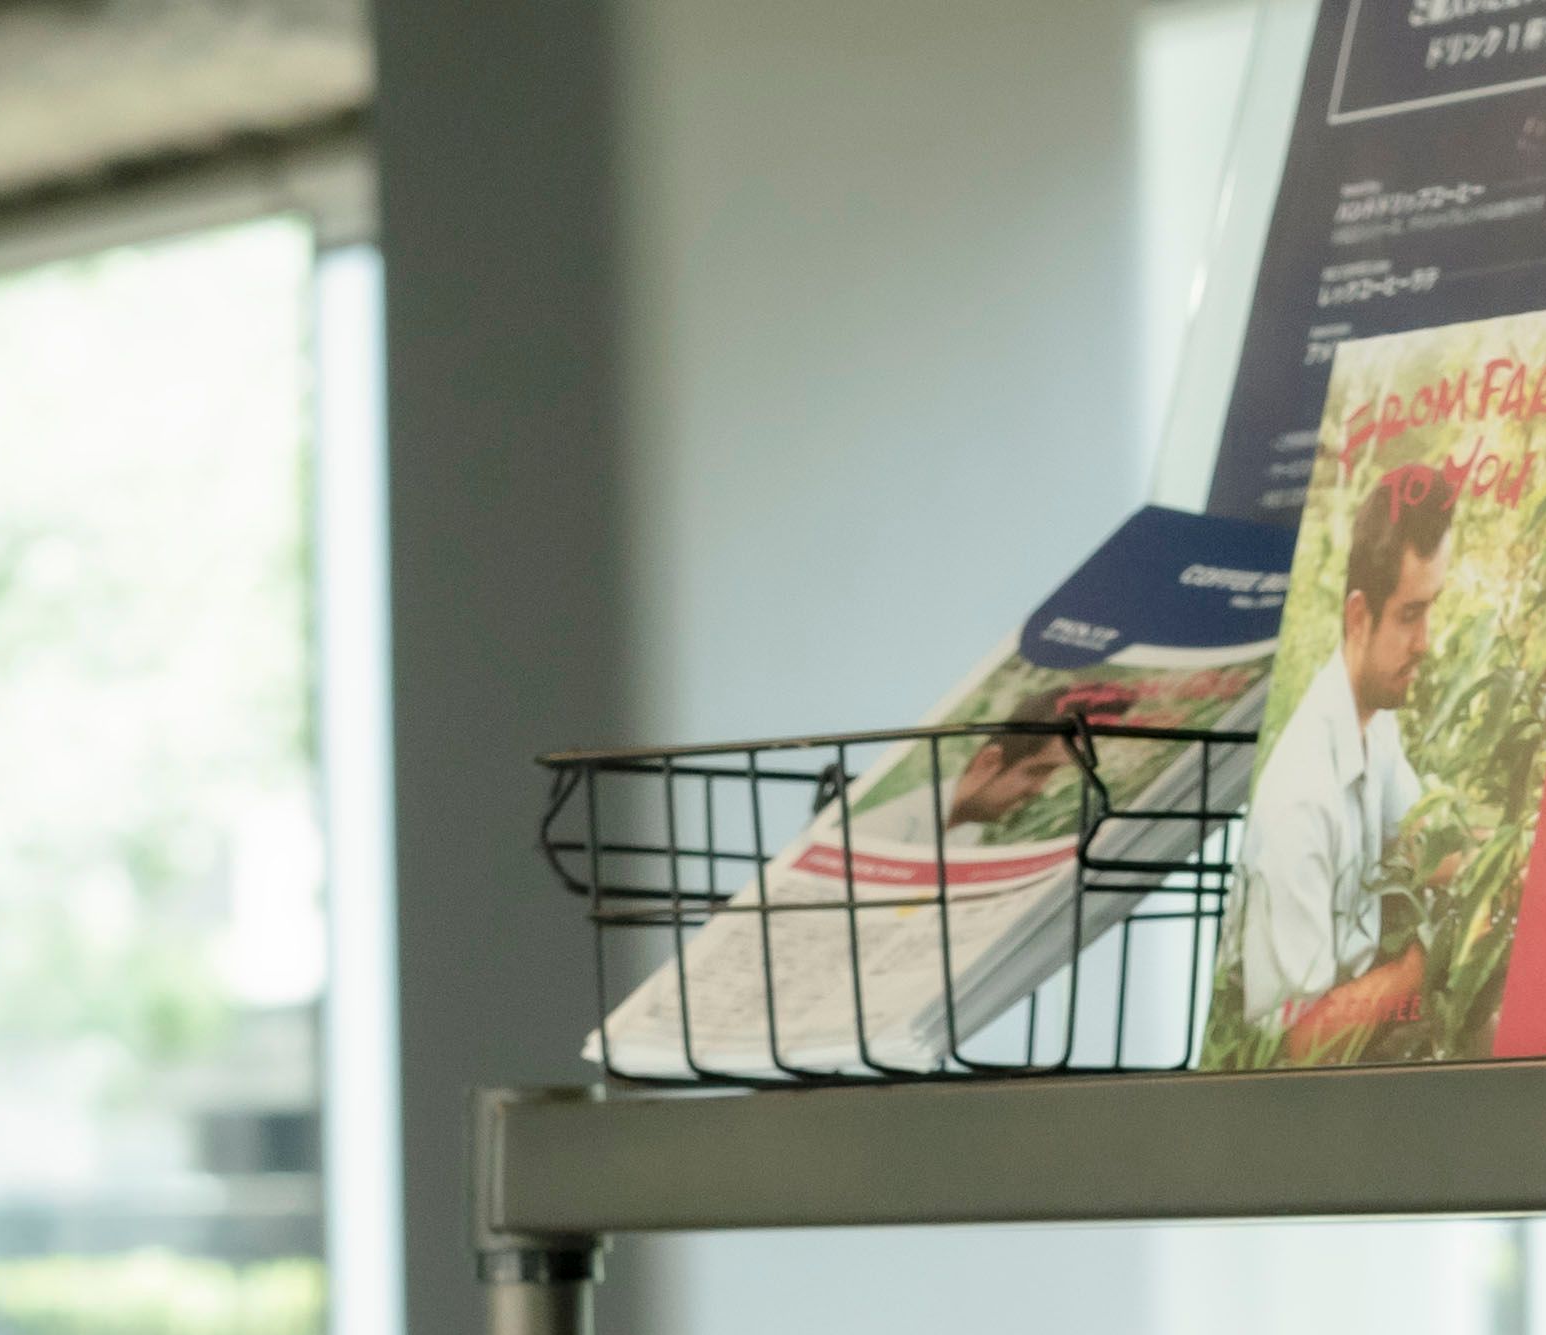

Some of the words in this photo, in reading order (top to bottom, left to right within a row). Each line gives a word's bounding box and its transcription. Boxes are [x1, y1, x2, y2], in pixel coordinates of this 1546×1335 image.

[1339, 368, 1468, 482] FROM
[1381, 463, 1436, 528] TO
[1444, 436, 1538, 511] YOU
